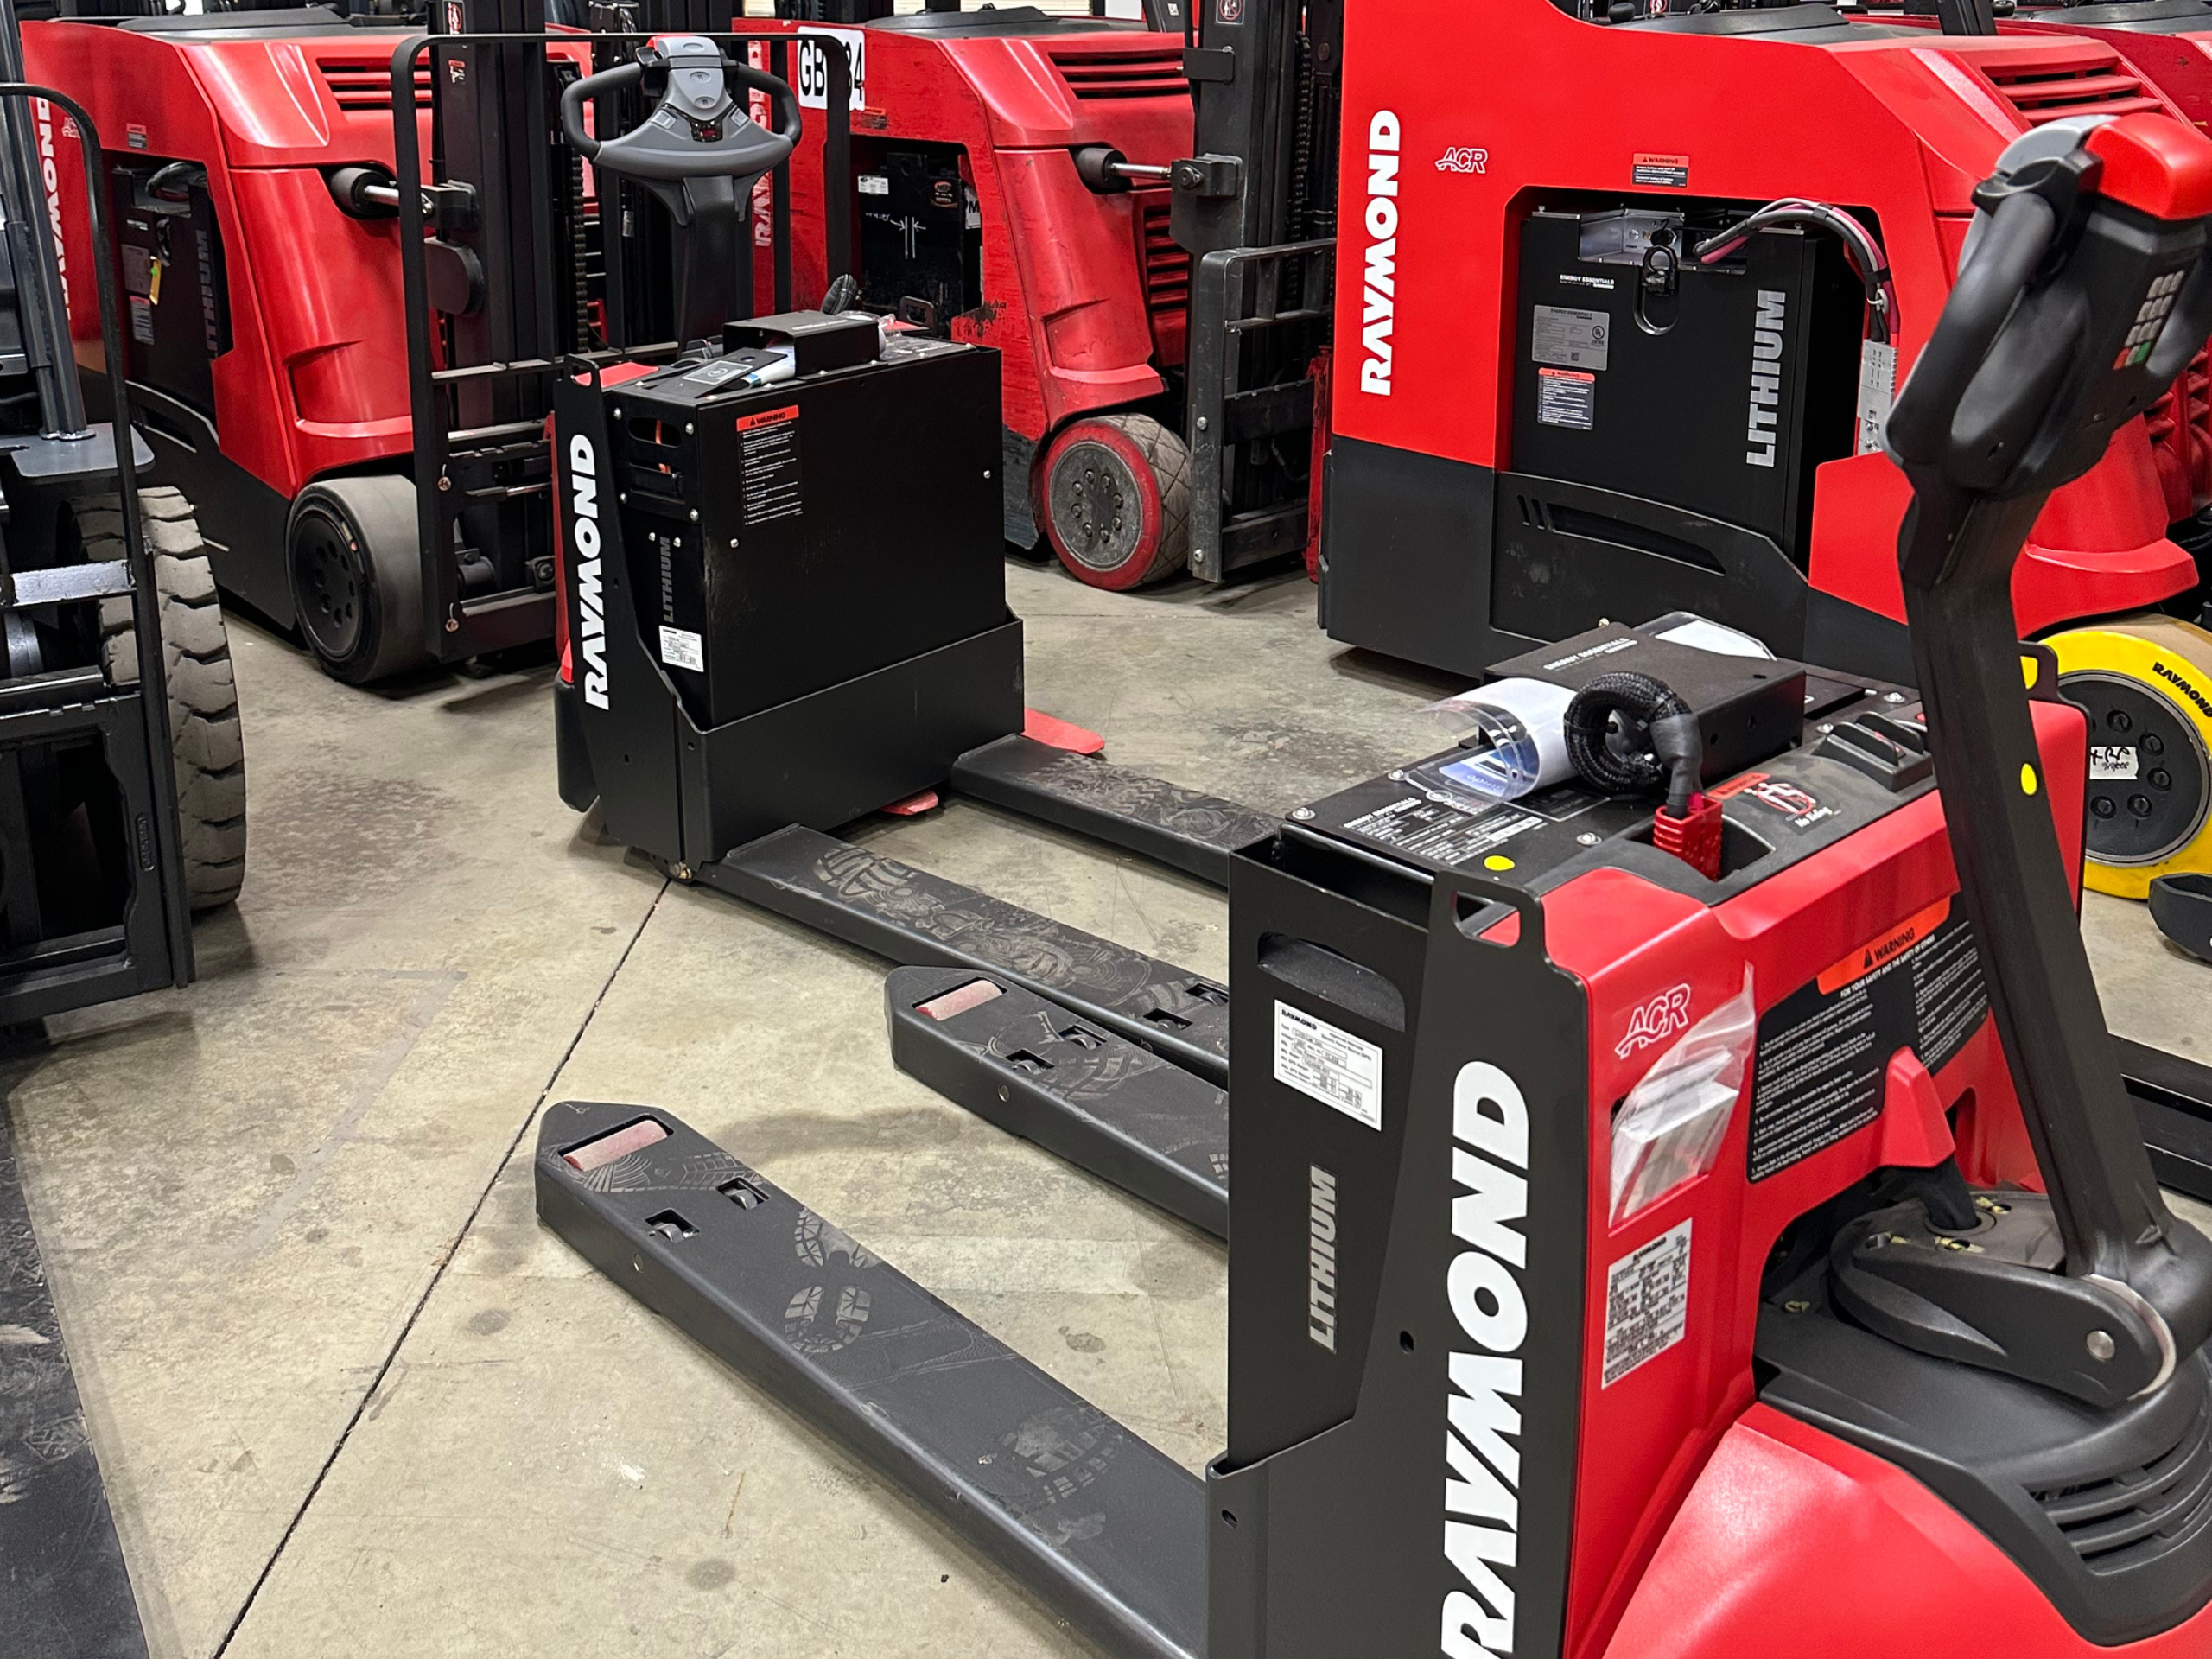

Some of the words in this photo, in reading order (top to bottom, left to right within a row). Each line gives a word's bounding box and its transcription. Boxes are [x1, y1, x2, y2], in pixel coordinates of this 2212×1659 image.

[1435, 147, 1488, 174] ACR
[196, 229, 219, 365] ITHIUM
[1361, 110, 1400, 396] RAYMOND
[1746, 289, 1786, 467] LITHIUM
[569, 434, 609, 711] RAYMOND
[659, 536, 674, 623] LITHIUM
[2152, 662, 2212, 717] RAYMOND
[1874, 927, 1915, 961] WARNING
[1614, 982, 1691, 1060] ACR
[1309, 1164, 1337, 1351] LITHIUM
[1440, 1060, 1529, 1659] RAYMOND
